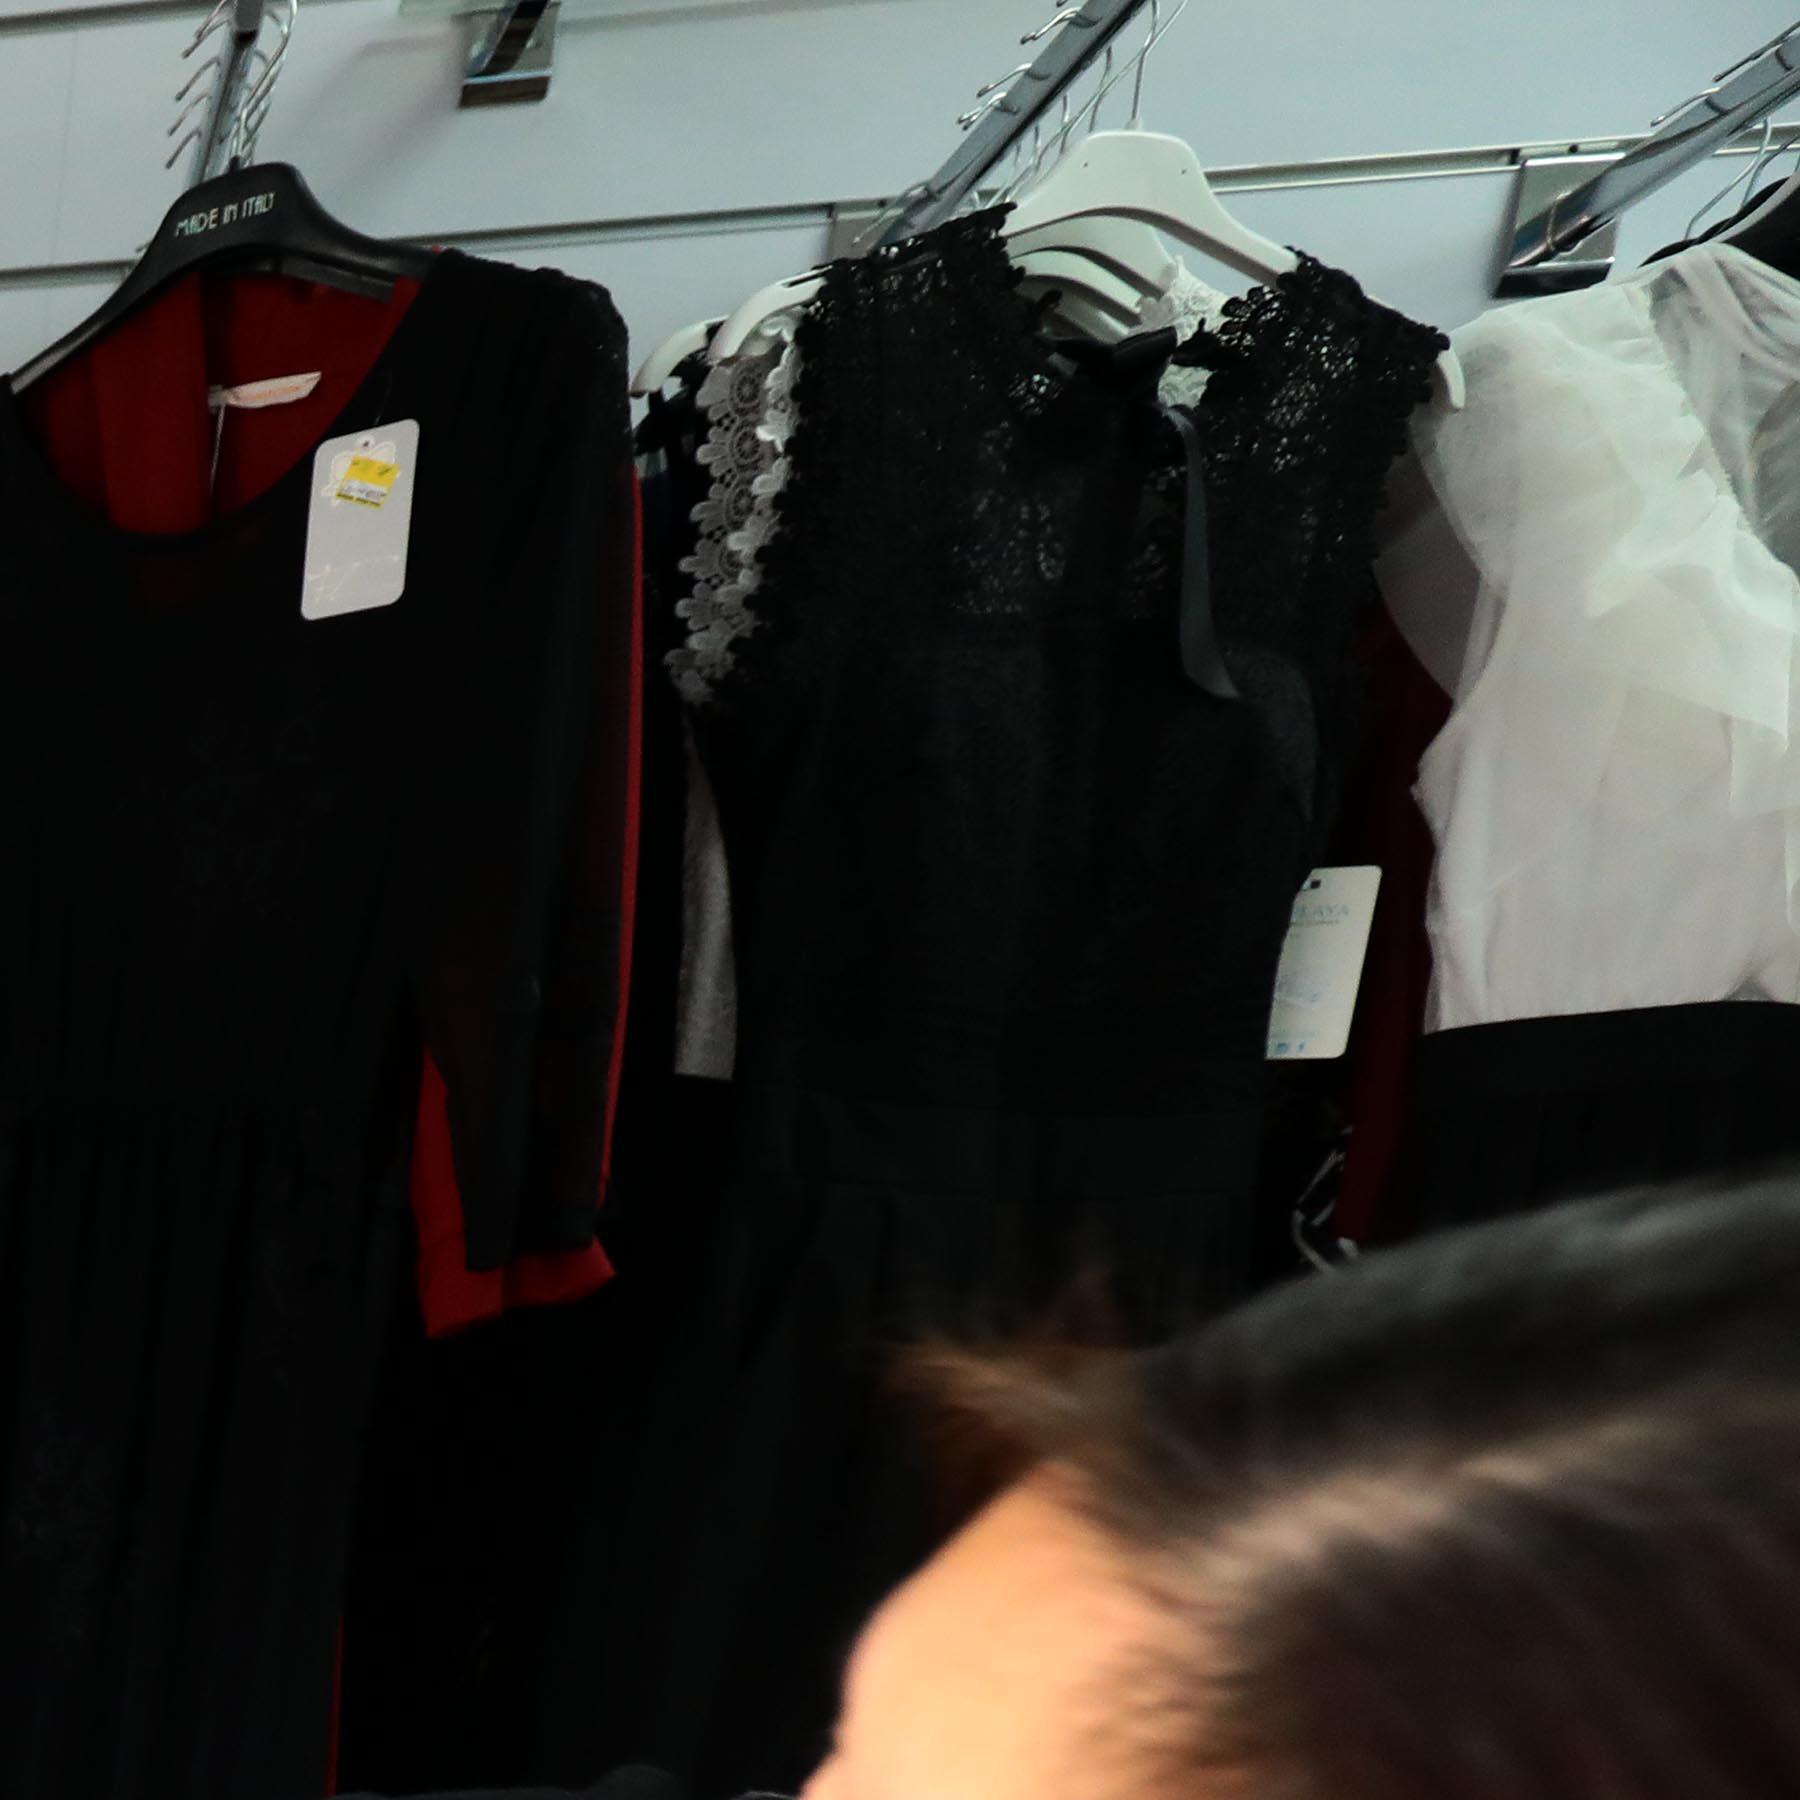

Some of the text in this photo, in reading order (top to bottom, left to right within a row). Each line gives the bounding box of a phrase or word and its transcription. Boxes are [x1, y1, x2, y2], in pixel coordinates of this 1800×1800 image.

[174, 192, 275, 237] MADE IN ITALY
